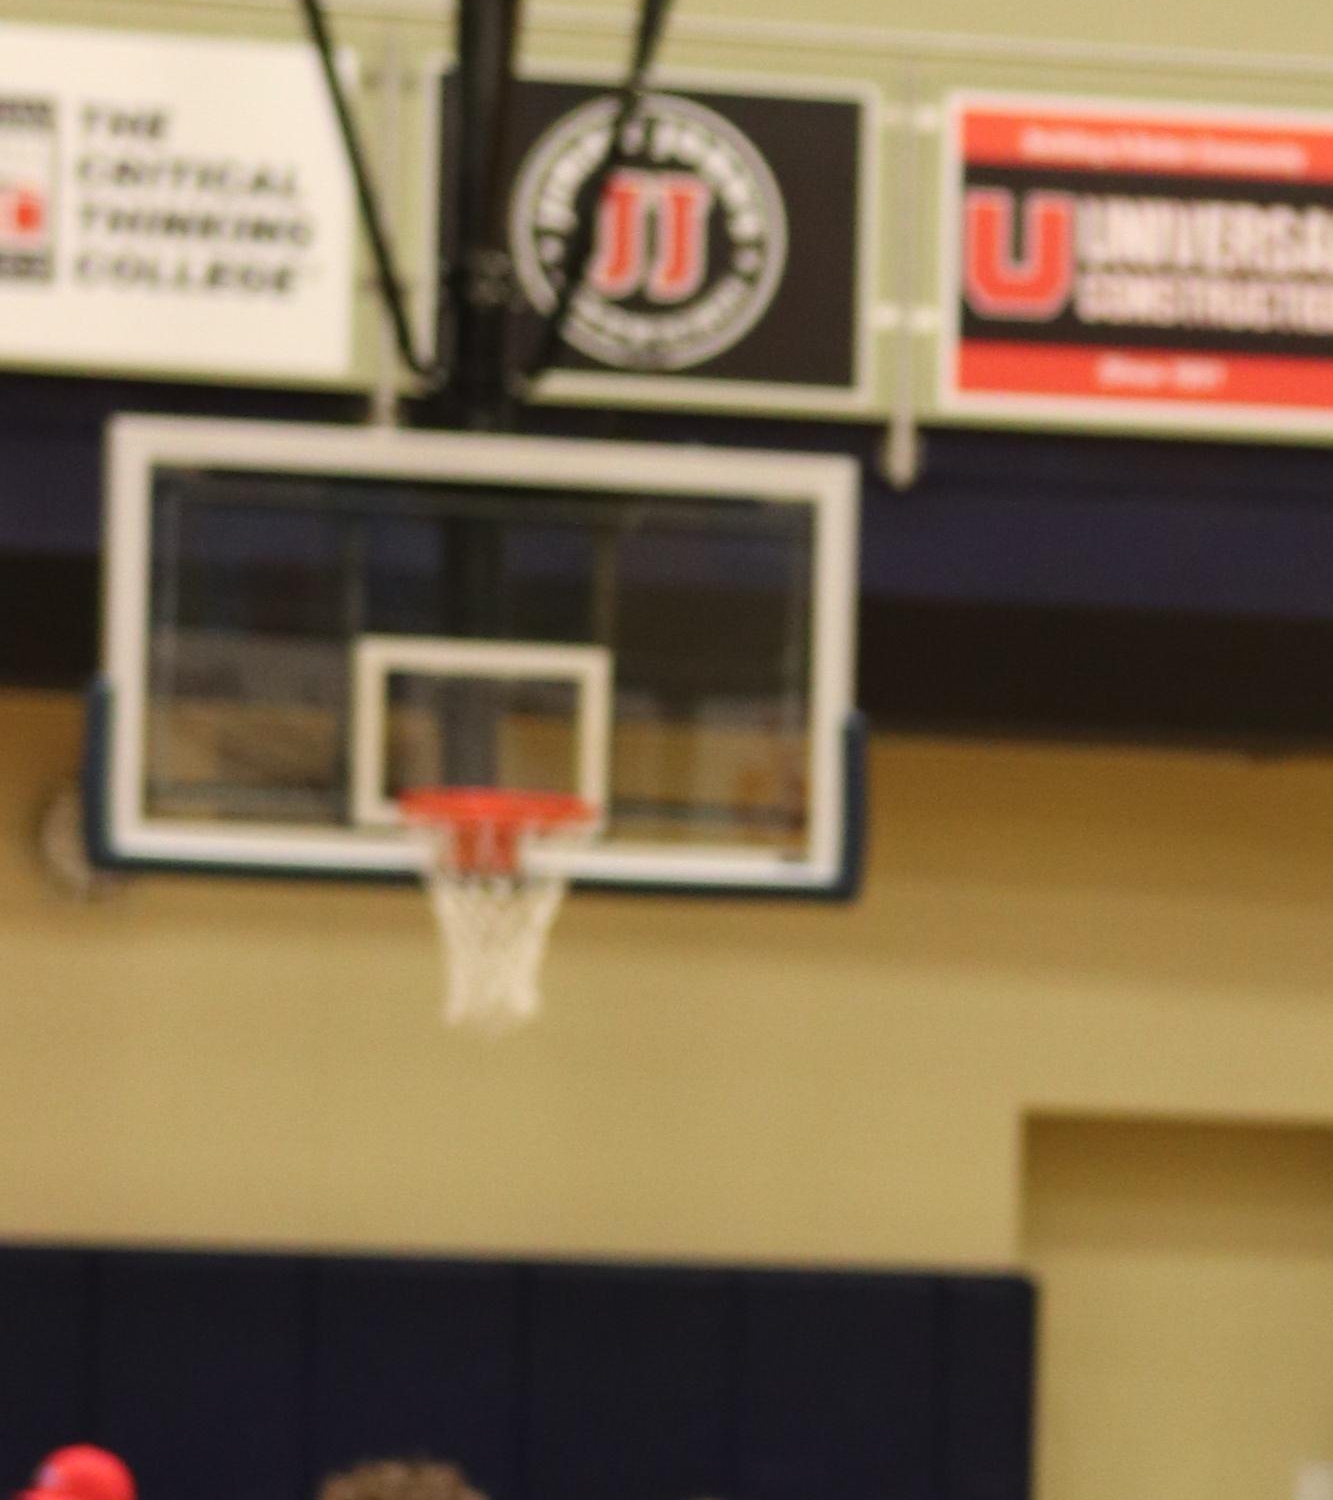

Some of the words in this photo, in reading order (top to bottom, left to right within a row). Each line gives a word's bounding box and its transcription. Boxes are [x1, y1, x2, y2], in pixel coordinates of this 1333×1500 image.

[75, 153, 302, 198] CRITICAL
[77, 202, 310, 248] THINKING
[72, 249, 295, 296] COLLEGE
